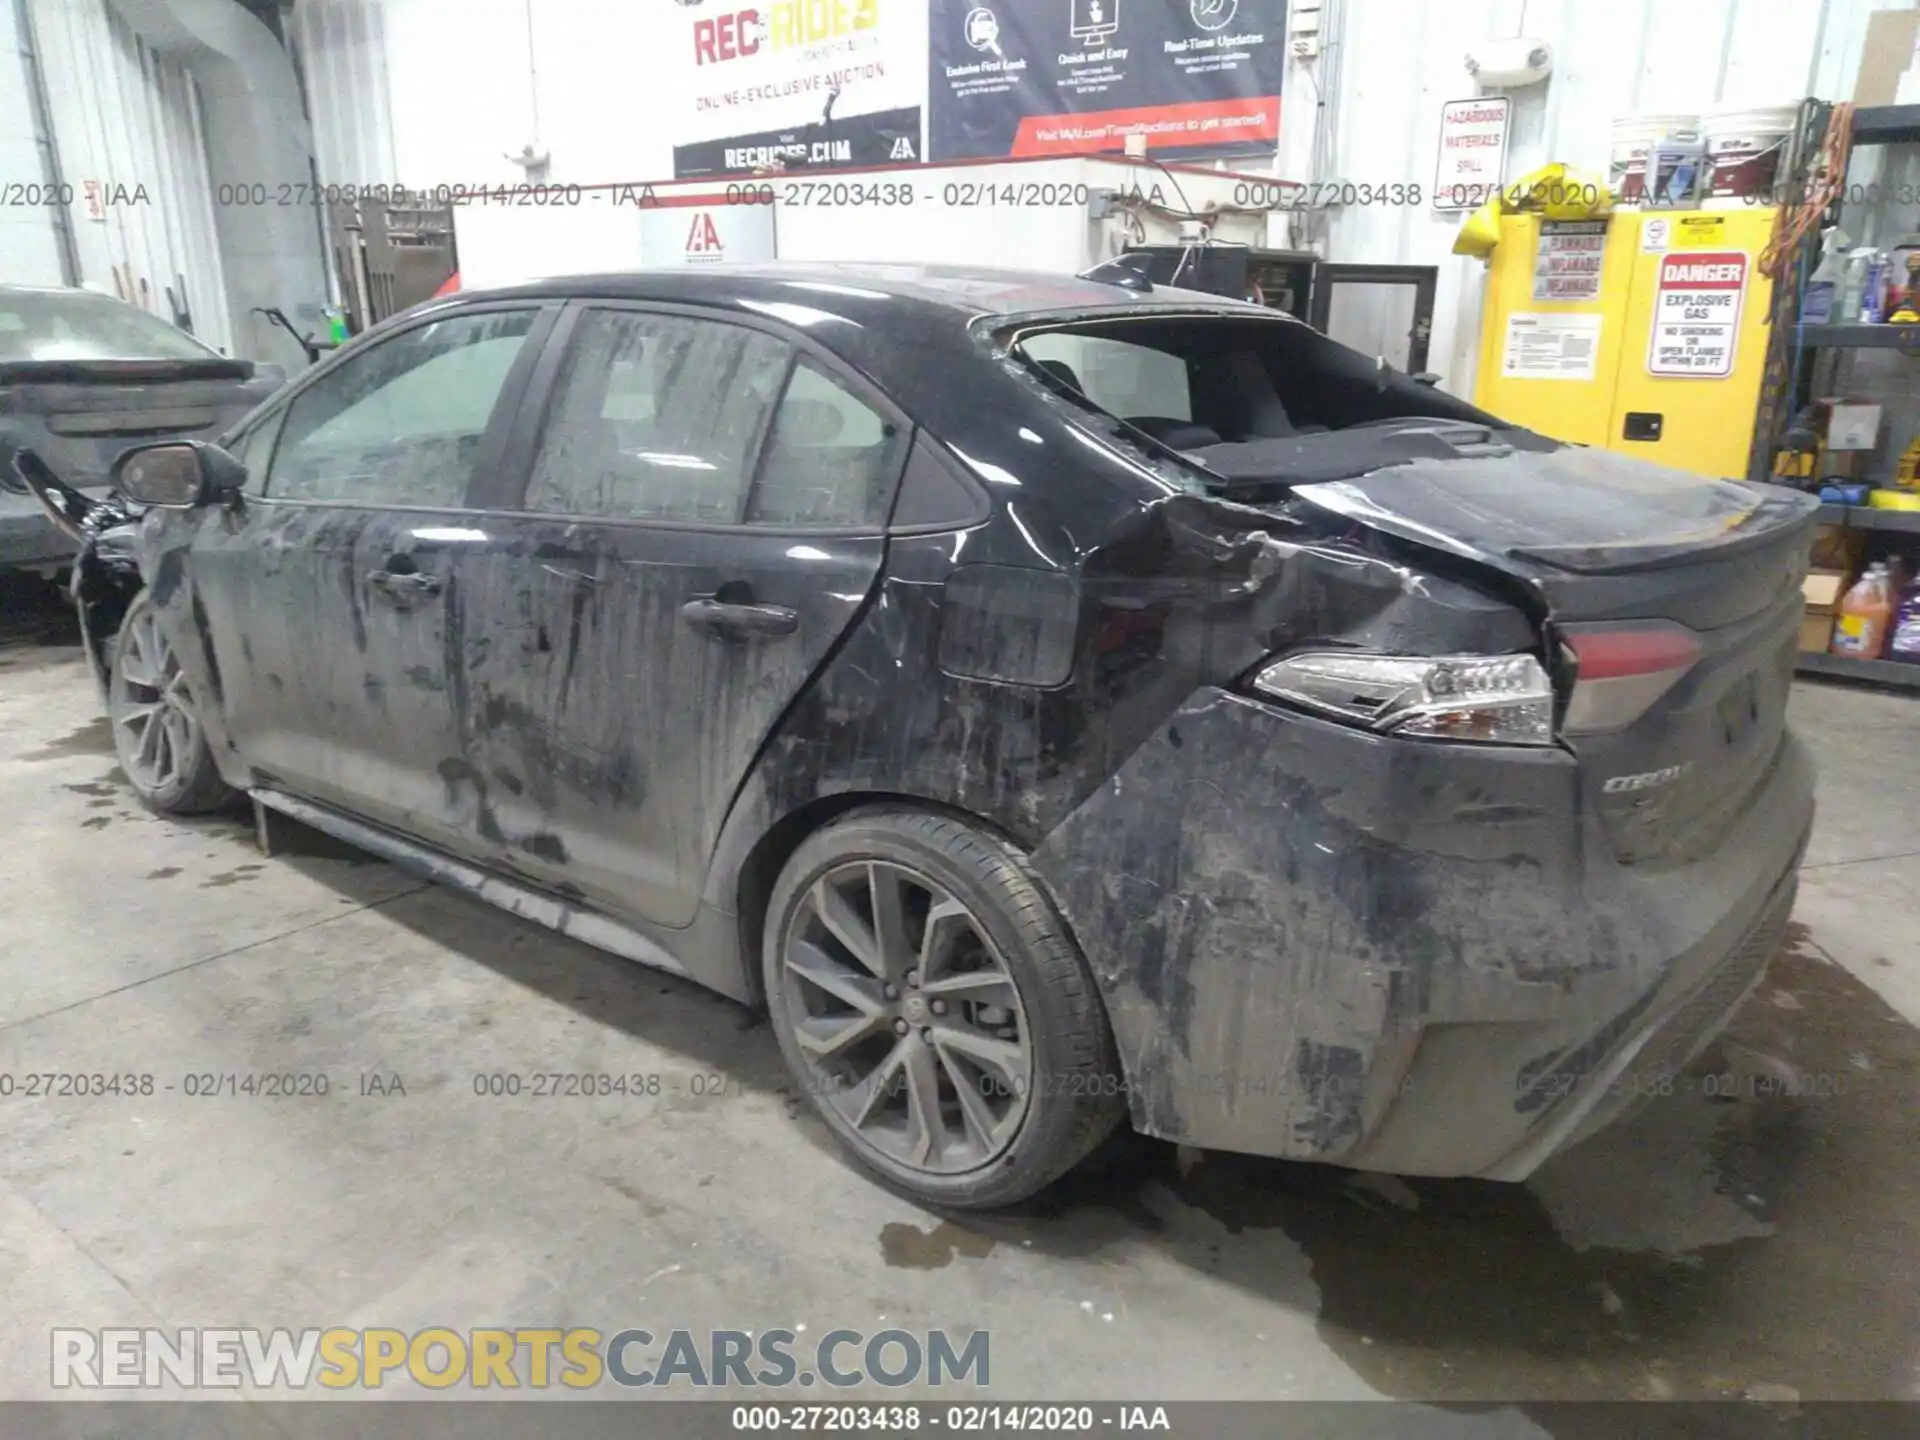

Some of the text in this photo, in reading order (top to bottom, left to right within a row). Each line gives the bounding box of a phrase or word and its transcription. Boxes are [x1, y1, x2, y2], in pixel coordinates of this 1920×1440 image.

[693, 9, 760, 66] REC
[1217, 33, 1264, 47] Updates
[1106, 48, 1129, 61] Easy
[823, 61, 885, 87] AUCTION
[1445, 108, 1505, 123] HAZARDOUS
[1446, 133, 1501, 148] MATERIALS
[1664, 263, 1743, 282] DANGER
[1665, 294, 1732, 307] EXPLOSIVE
[1684, 307, 1709, 319] GAS
[1664, 326, 1678, 336] NO
[1686, 337, 1699, 346] OR
[1660, 346, 1683, 355] OPEN
